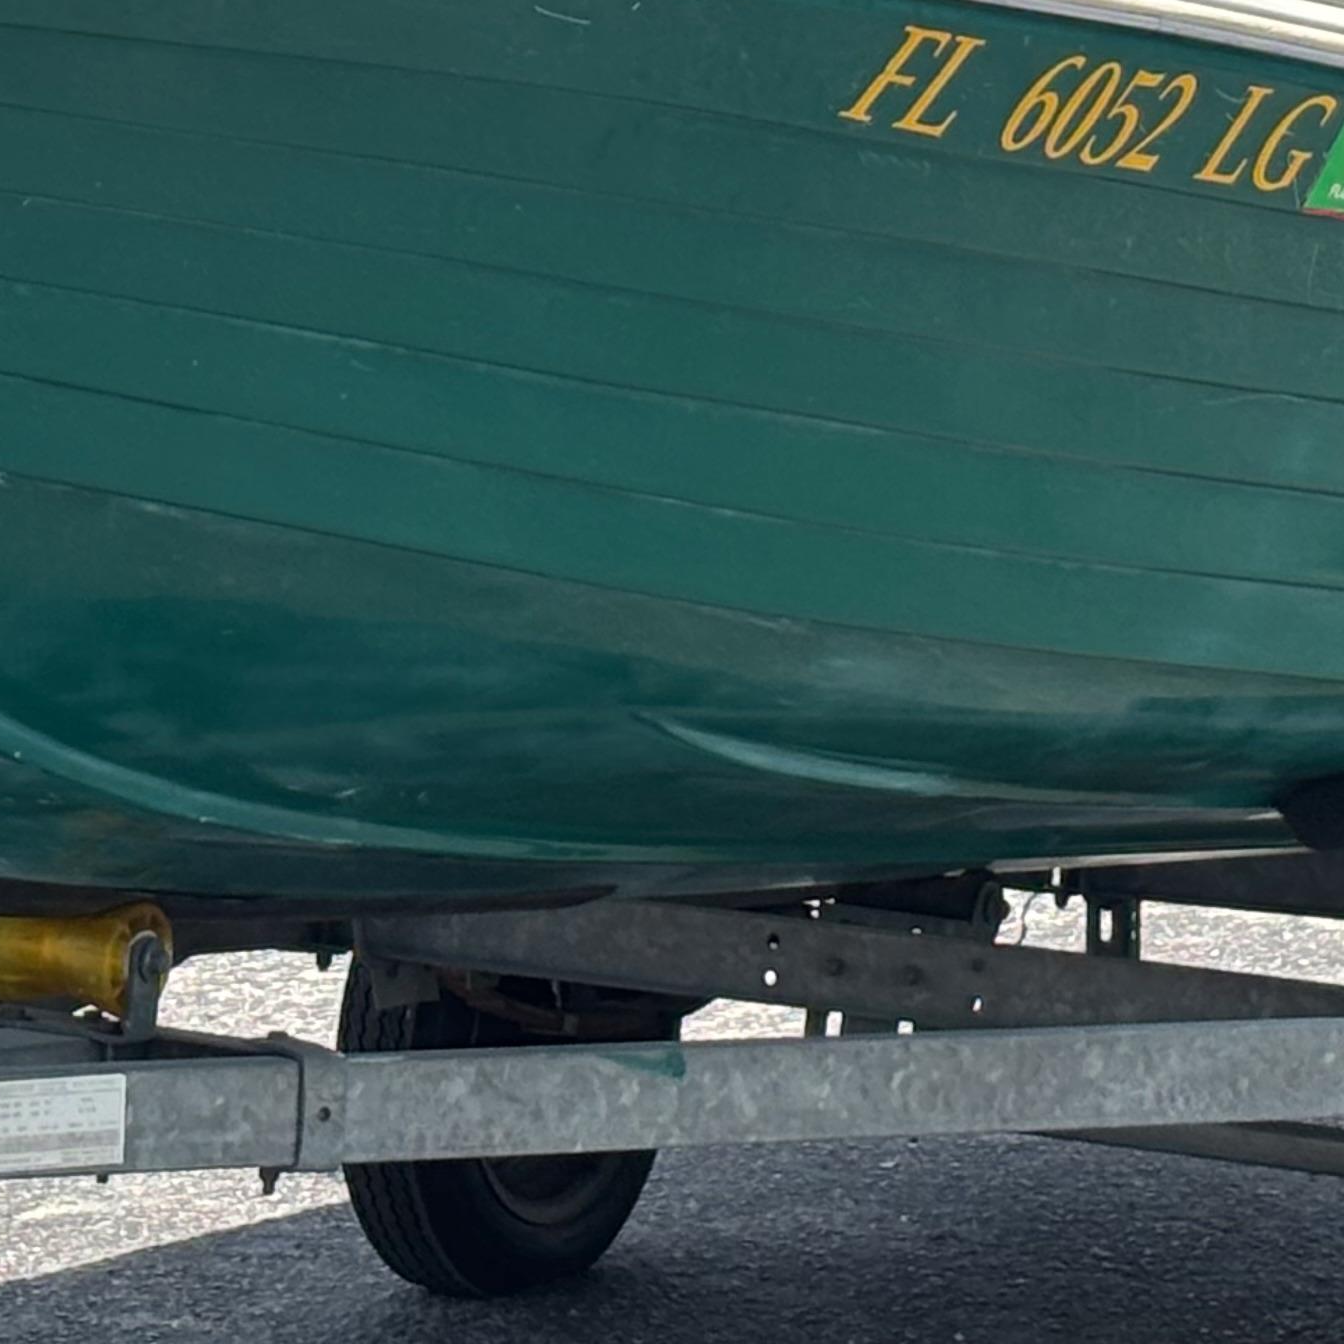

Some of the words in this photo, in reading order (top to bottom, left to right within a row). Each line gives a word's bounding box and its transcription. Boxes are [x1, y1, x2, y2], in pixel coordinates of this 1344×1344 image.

[837, 24, 987, 138] FL
[999, 55, 1198, 172] 6052
[1193, 85, 1338, 192] LG
